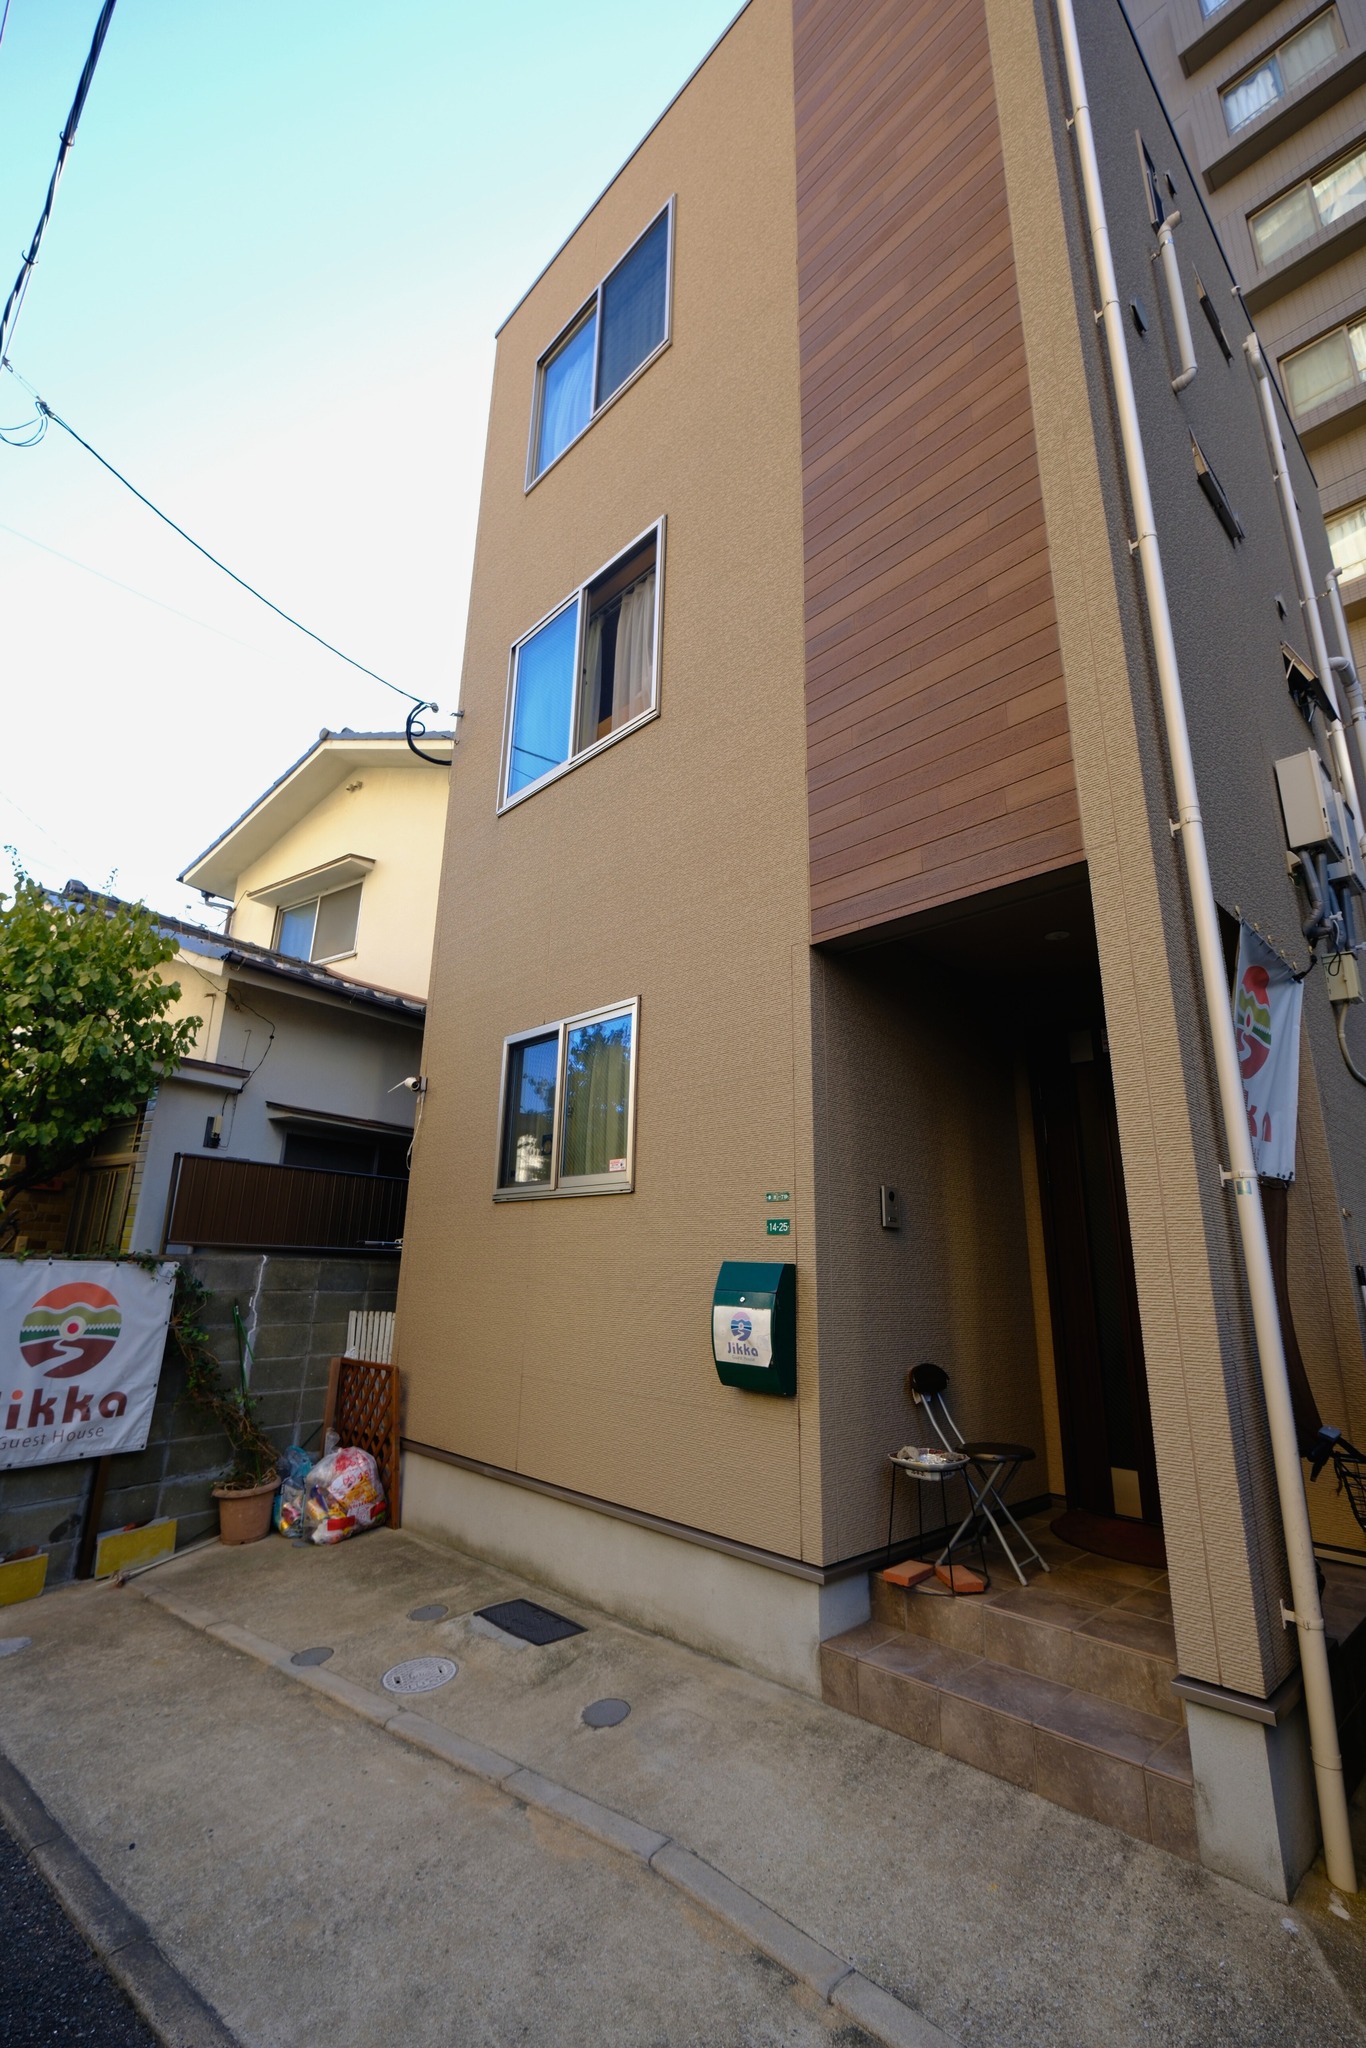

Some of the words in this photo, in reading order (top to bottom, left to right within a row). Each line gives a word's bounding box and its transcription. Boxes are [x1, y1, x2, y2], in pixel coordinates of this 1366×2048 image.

[769, 1222, 788, 1231] 14-25
[728, 1341, 758, 1356] Jikka
[0, 1385, 127, 1430] ikka
[52, 1426, 104, 1443] House
